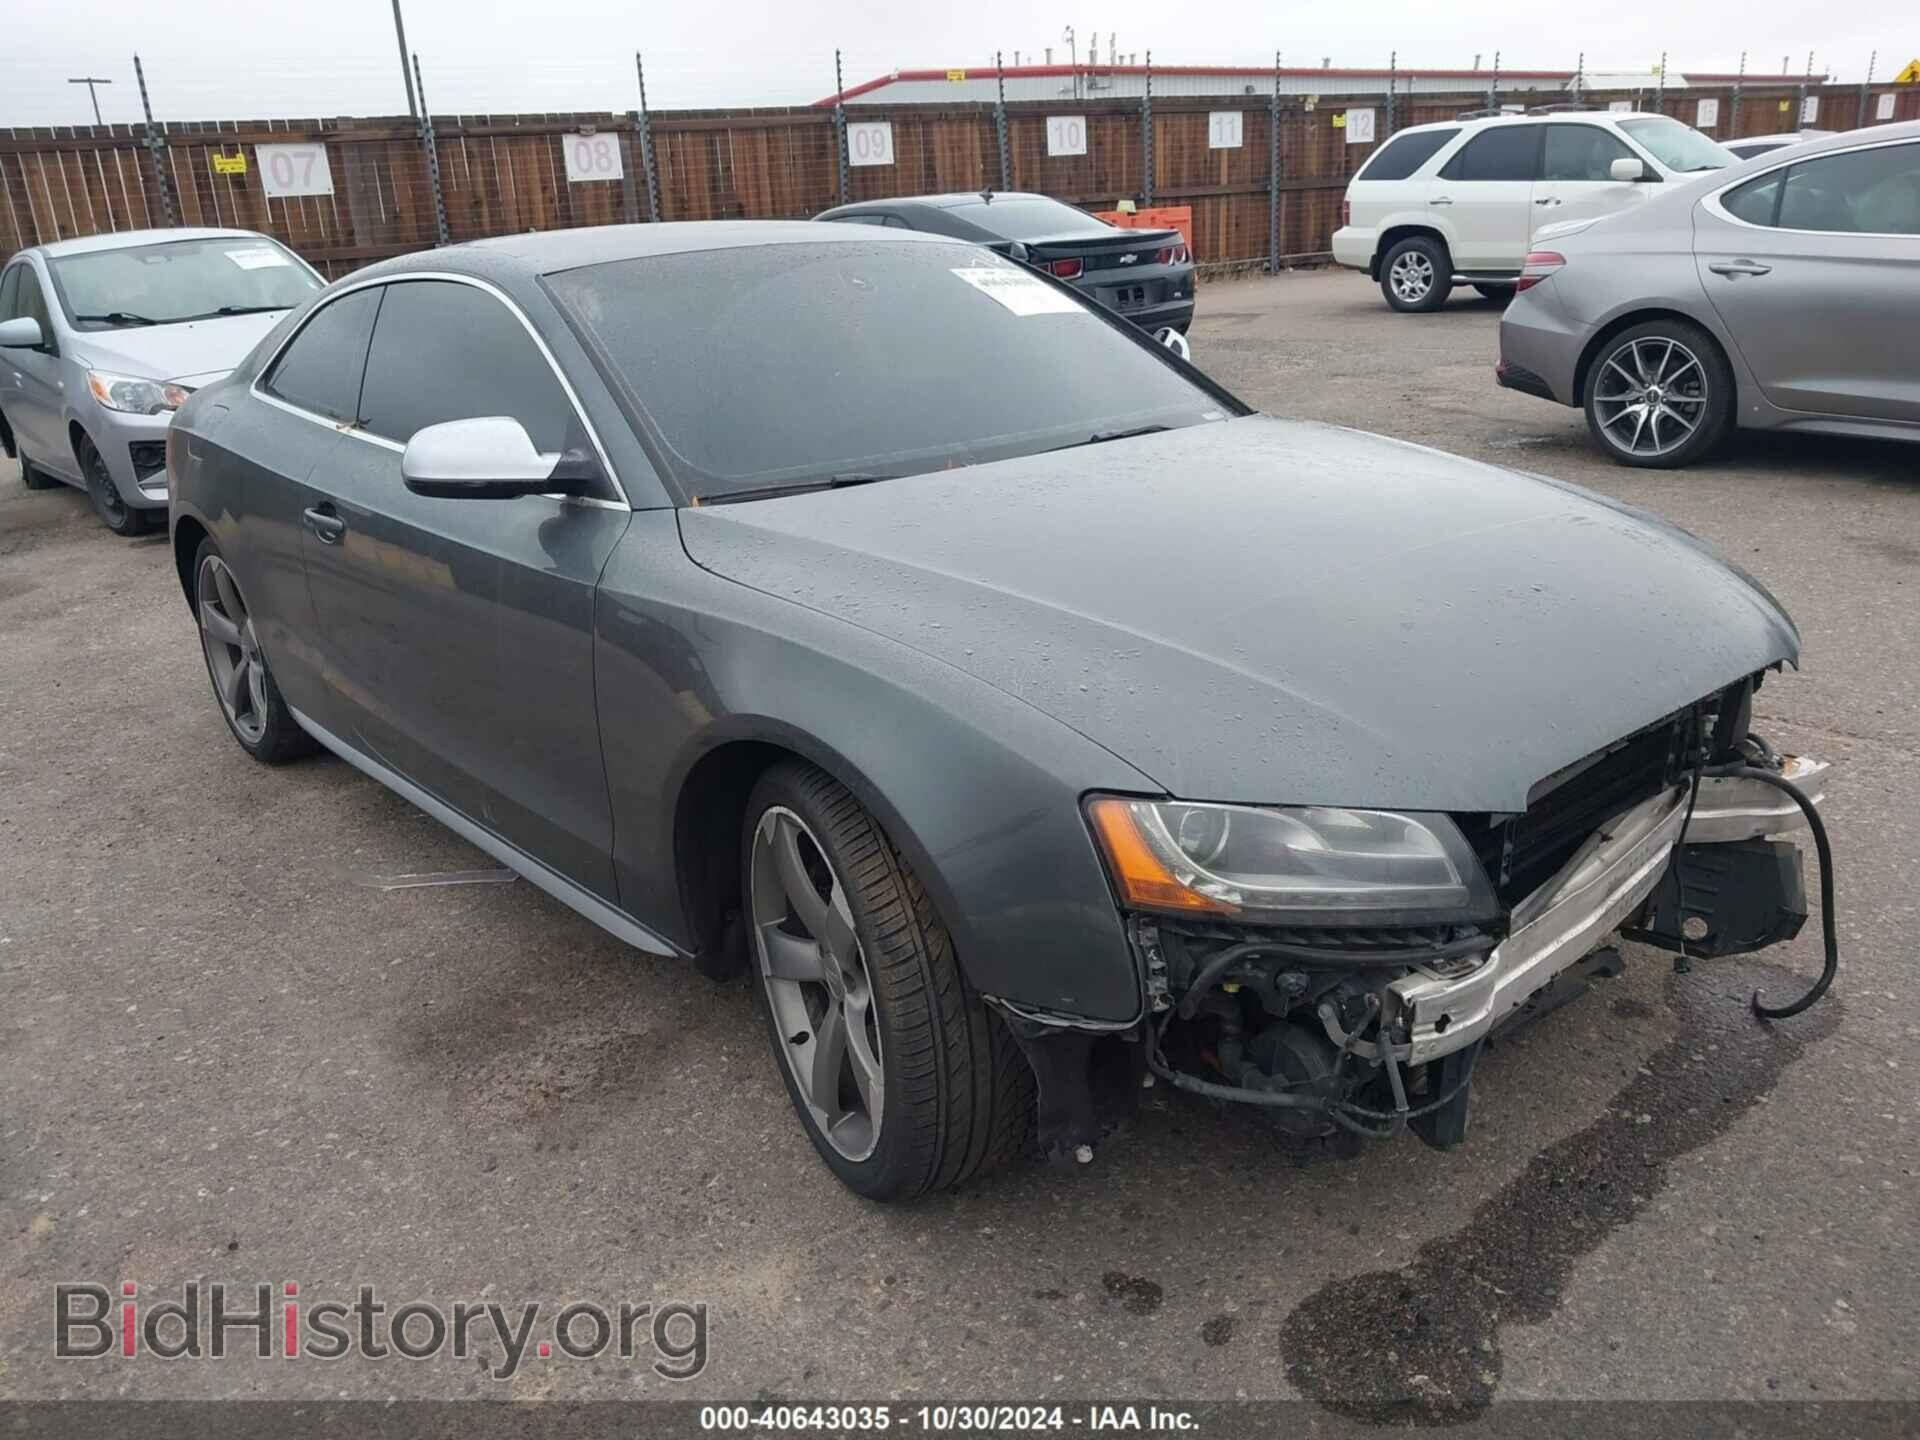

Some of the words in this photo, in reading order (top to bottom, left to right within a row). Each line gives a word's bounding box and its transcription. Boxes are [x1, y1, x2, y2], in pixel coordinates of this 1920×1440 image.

[1055, 122, 1080, 149] 10
[1216, 117, 1235, 142] 11
[1352, 112, 1370, 137] 12
[575, 140, 613, 173] 08
[855, 129, 885, 159] 09
[270, 151, 317, 188] 07
